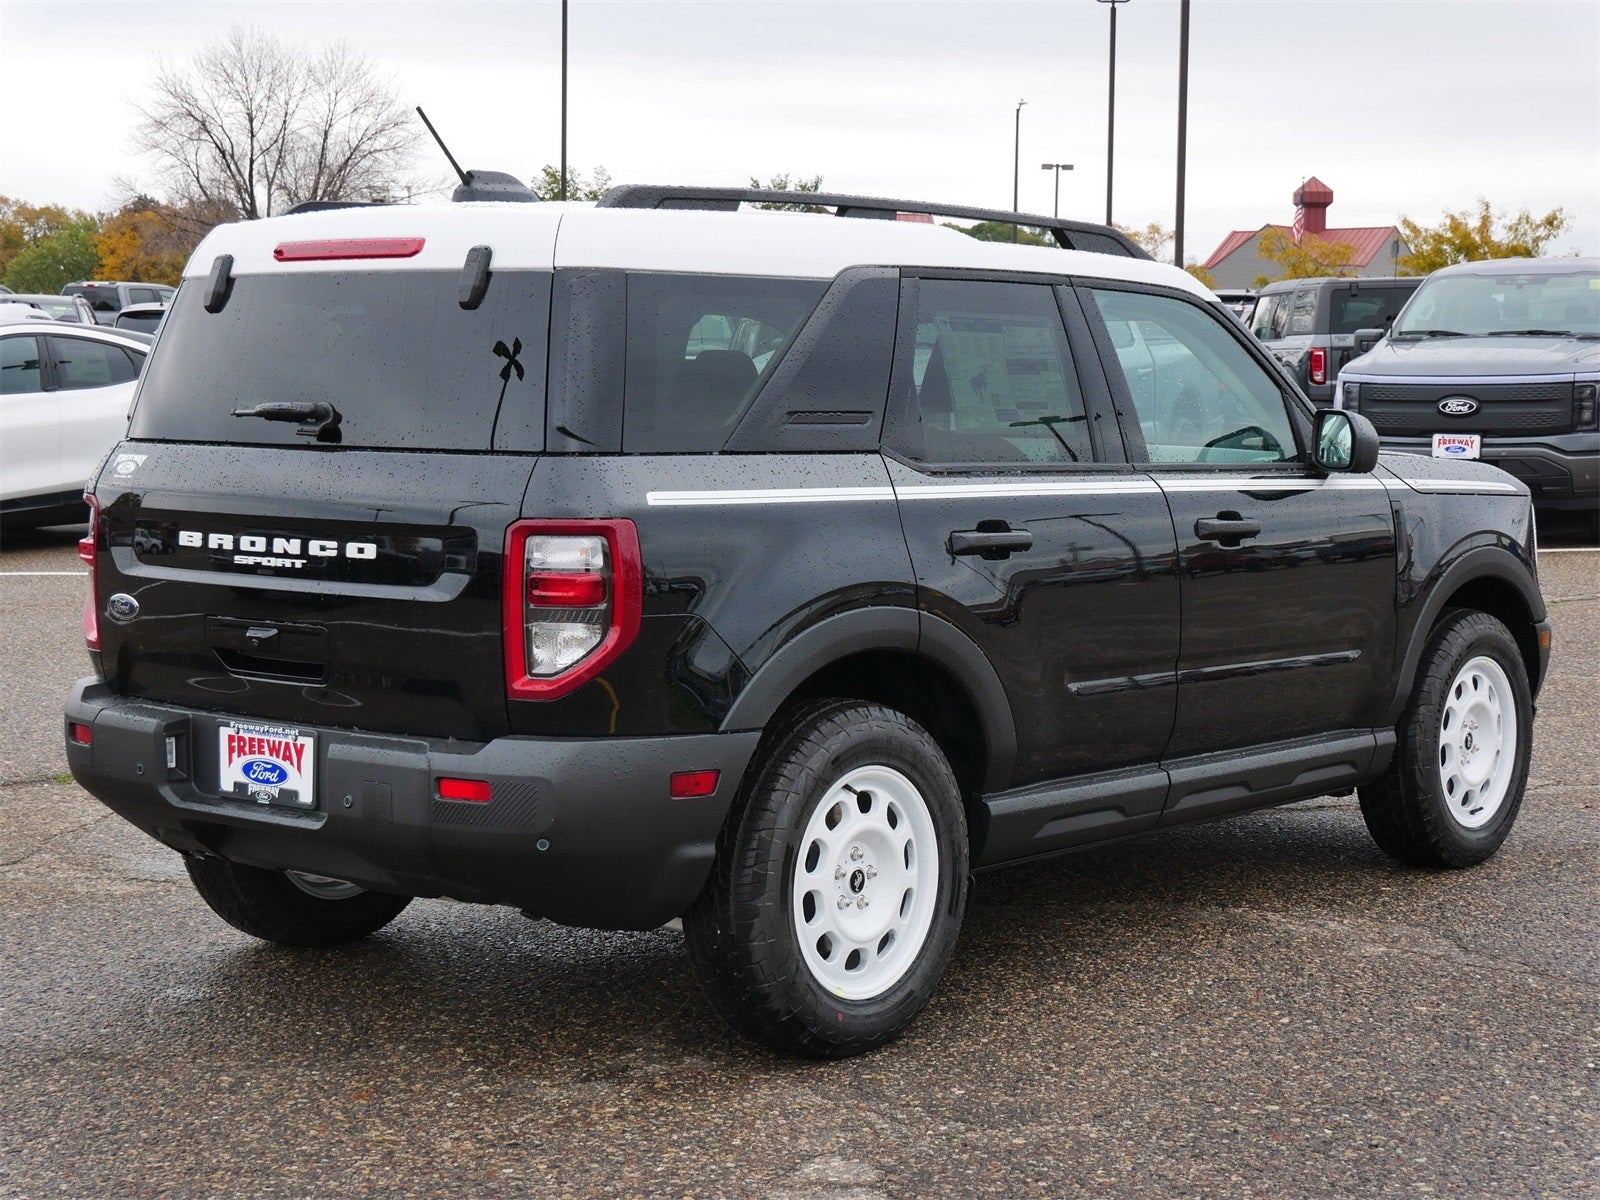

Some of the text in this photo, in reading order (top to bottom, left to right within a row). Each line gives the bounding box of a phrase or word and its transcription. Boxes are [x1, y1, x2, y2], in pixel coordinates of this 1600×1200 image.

[1445, 401, 1471, 412] Ford
[1437, 438, 1475, 449] FREEWAY
[178, 530, 377, 560] BRONCO
[233, 555, 307, 568] SPORT
[230, 721, 299, 736] FreewayFord.net
[227, 734, 306, 778] FREEWAY
[249, 761, 279, 783] Ford
[247, 783, 281, 798] FREEWAY
